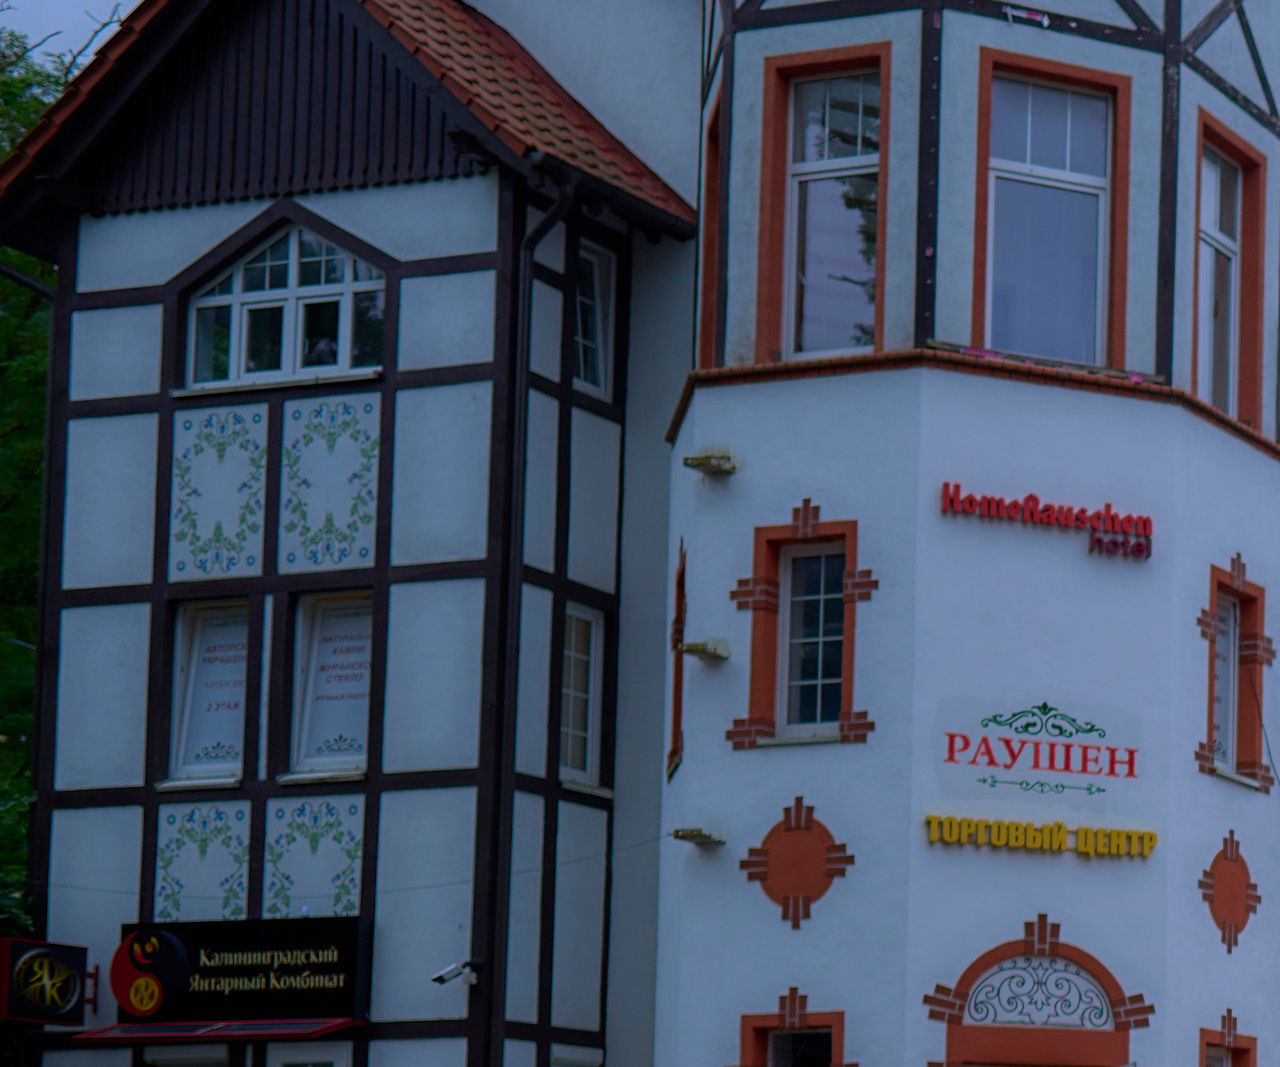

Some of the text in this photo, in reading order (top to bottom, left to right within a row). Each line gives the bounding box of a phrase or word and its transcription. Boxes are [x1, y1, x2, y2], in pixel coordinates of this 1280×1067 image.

[942, 482, 1152, 537] HomeRauschen
[1091, 531, 1152, 558] hotel
[943, 732, 1138, 778] РАУШЕН
[926, 816, 1157, 857] ТОРГОВЫЙ ЦЕНТР
[200, 945, 338, 969] Калининградский
[189, 970, 346, 995] Янтарный Комбинат
